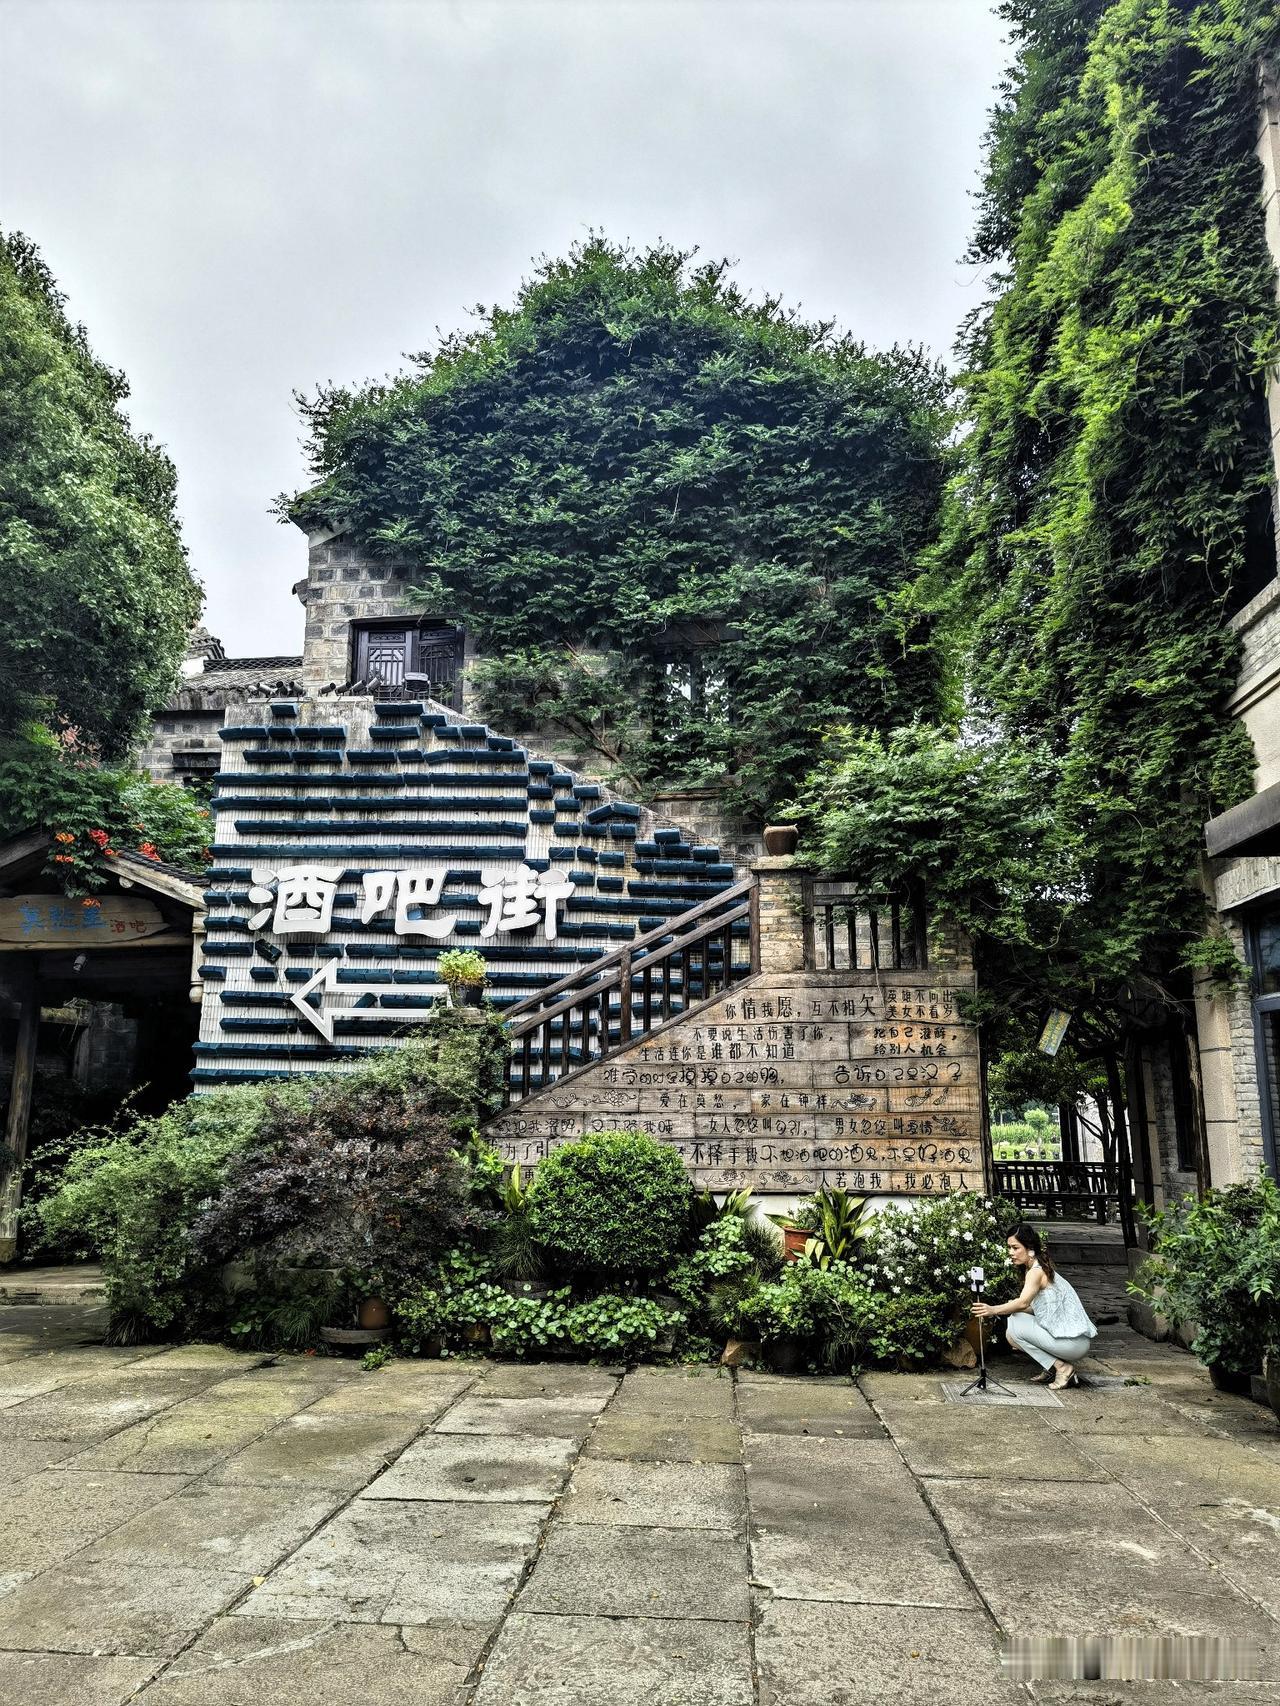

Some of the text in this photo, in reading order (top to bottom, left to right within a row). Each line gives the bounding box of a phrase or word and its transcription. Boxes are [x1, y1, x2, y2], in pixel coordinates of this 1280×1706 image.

[247, 863, 576, 941] 酒吧街
[110, 919, 147, 934] 酒吧
[887, 989, 955, 1004] 英雄不问出
[887, 1004, 955, 1019] 美女不看岁
[640, 1041, 796, 1062] 生活连你是谁都不知道
[874, 1043, 947, 1057] 给别人机会
[760, 1092, 826, 1110] 家在钟祥
[835, 1117, 933, 1136] 男女忽悠叫爱情
